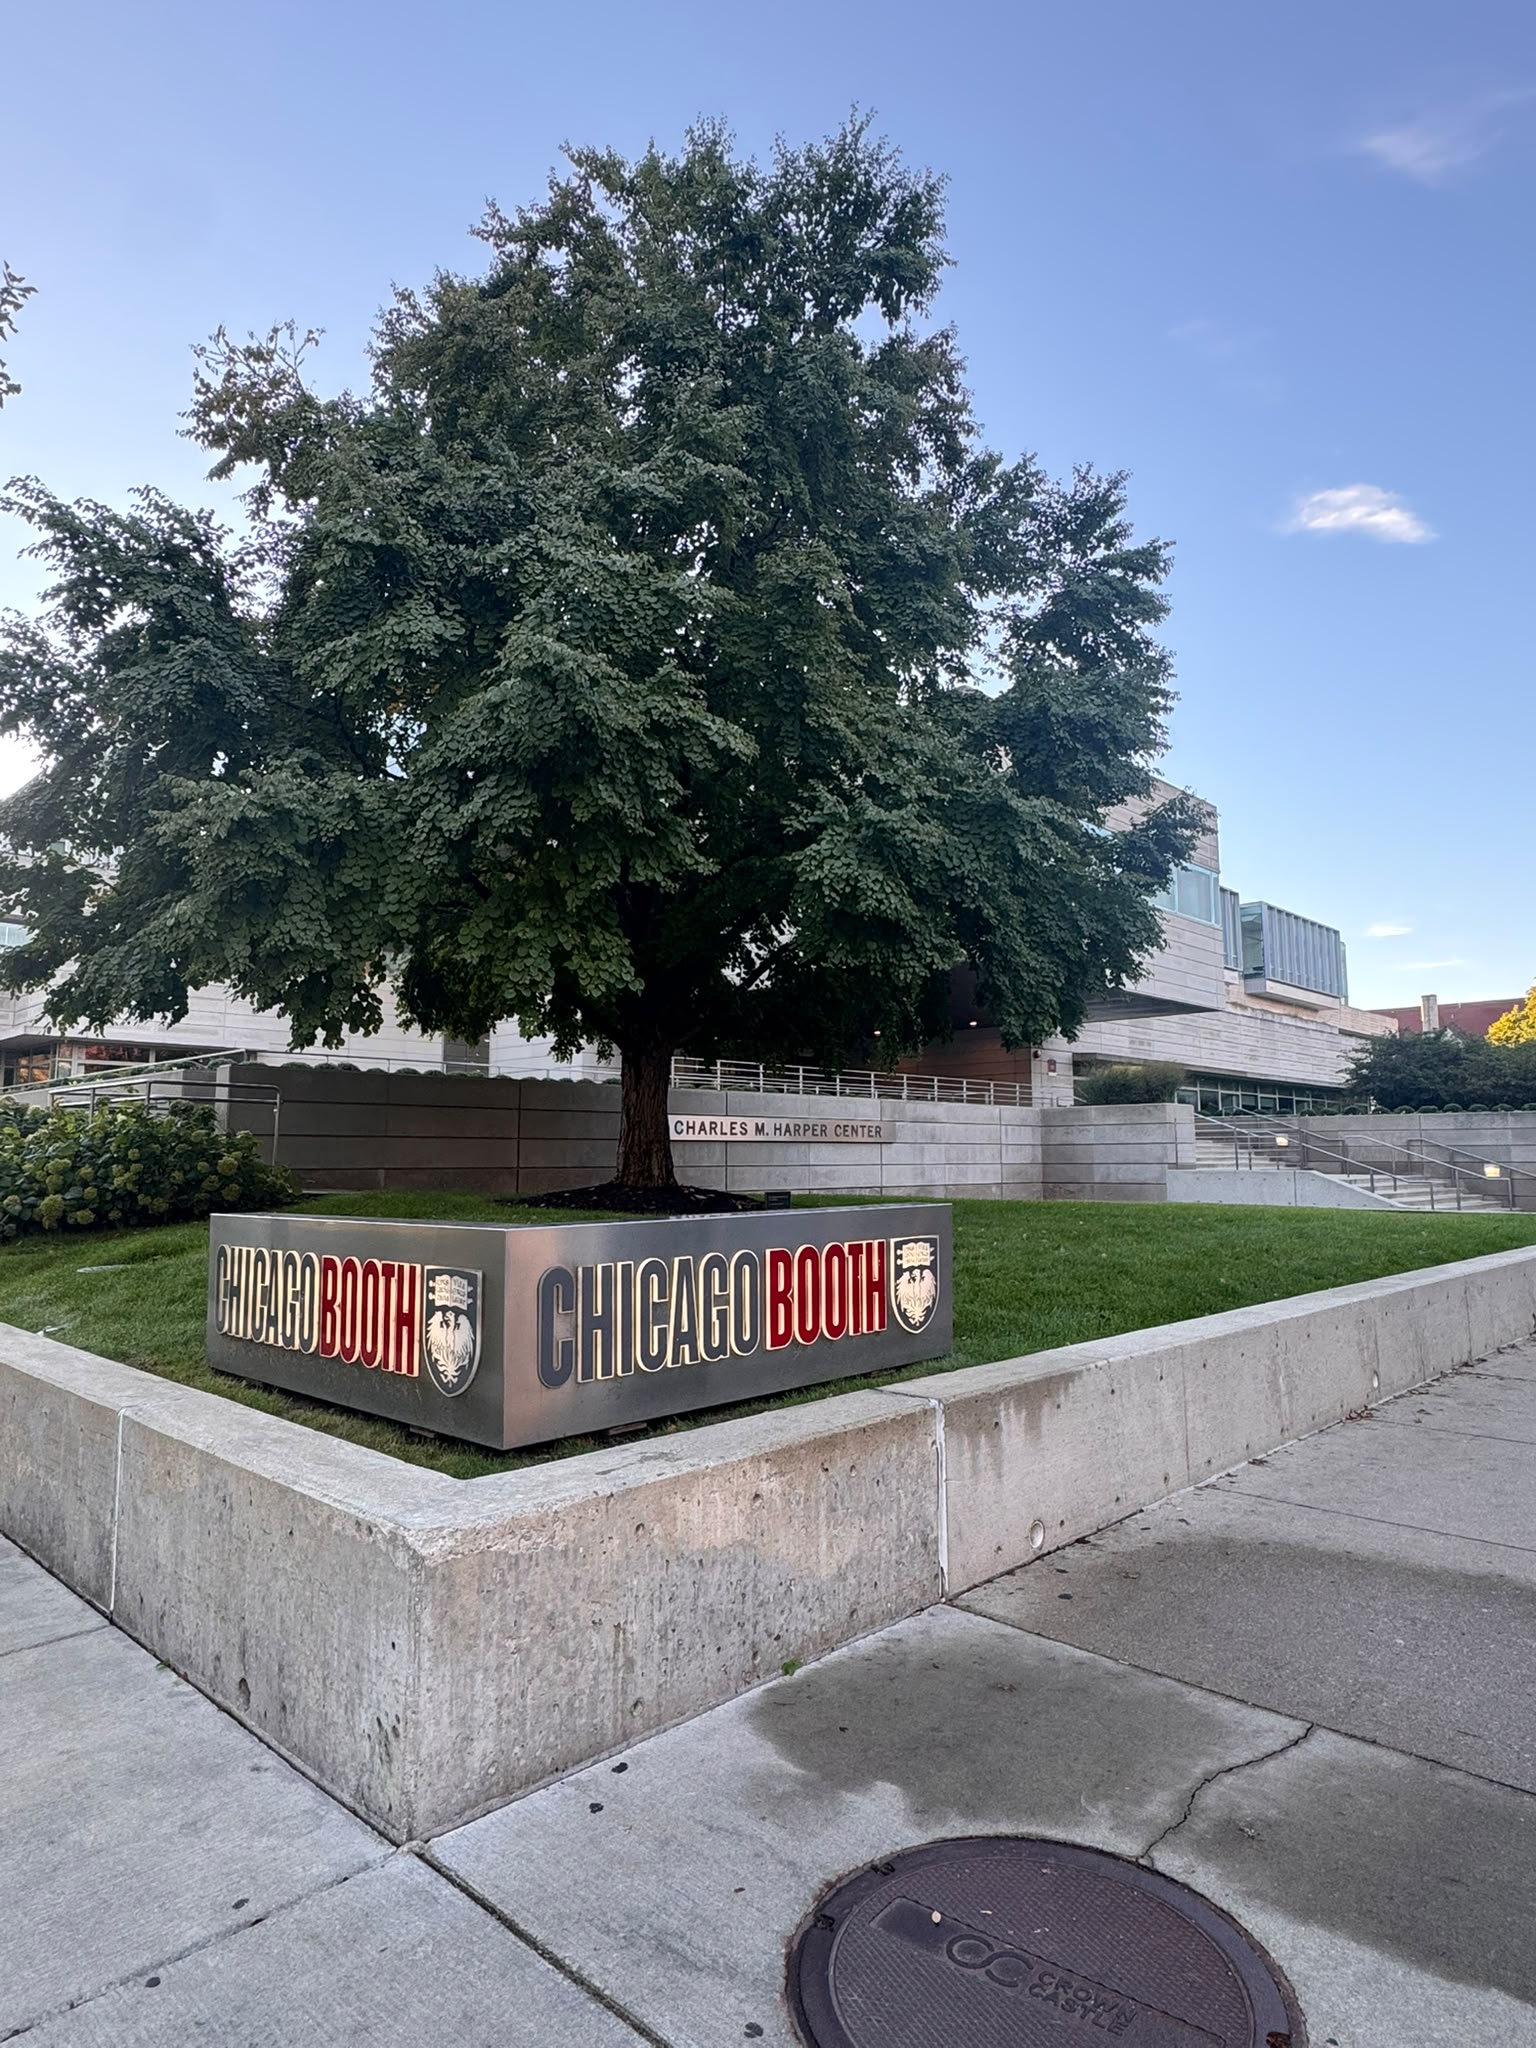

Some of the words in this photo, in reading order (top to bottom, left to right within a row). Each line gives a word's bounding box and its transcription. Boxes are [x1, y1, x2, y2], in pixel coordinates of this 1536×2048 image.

[673, 1119, 749, 1136] CHARLES
[754, 1122, 769, 1137] M.
[773, 1122, 828, 1138] HARPER
[834, 1124, 883, 1139] CENTER
[214, 1243, 320, 1355] CHICAGO
[319, 1254, 421, 1378] BOOTH
[537, 1249, 760, 1389] CHICAGO
[766, 1239, 887, 1351] BOOTH
[1028, 1983, 1124, 2037] CASTLE
[1038, 1970, 1138, 2028] CROWN
